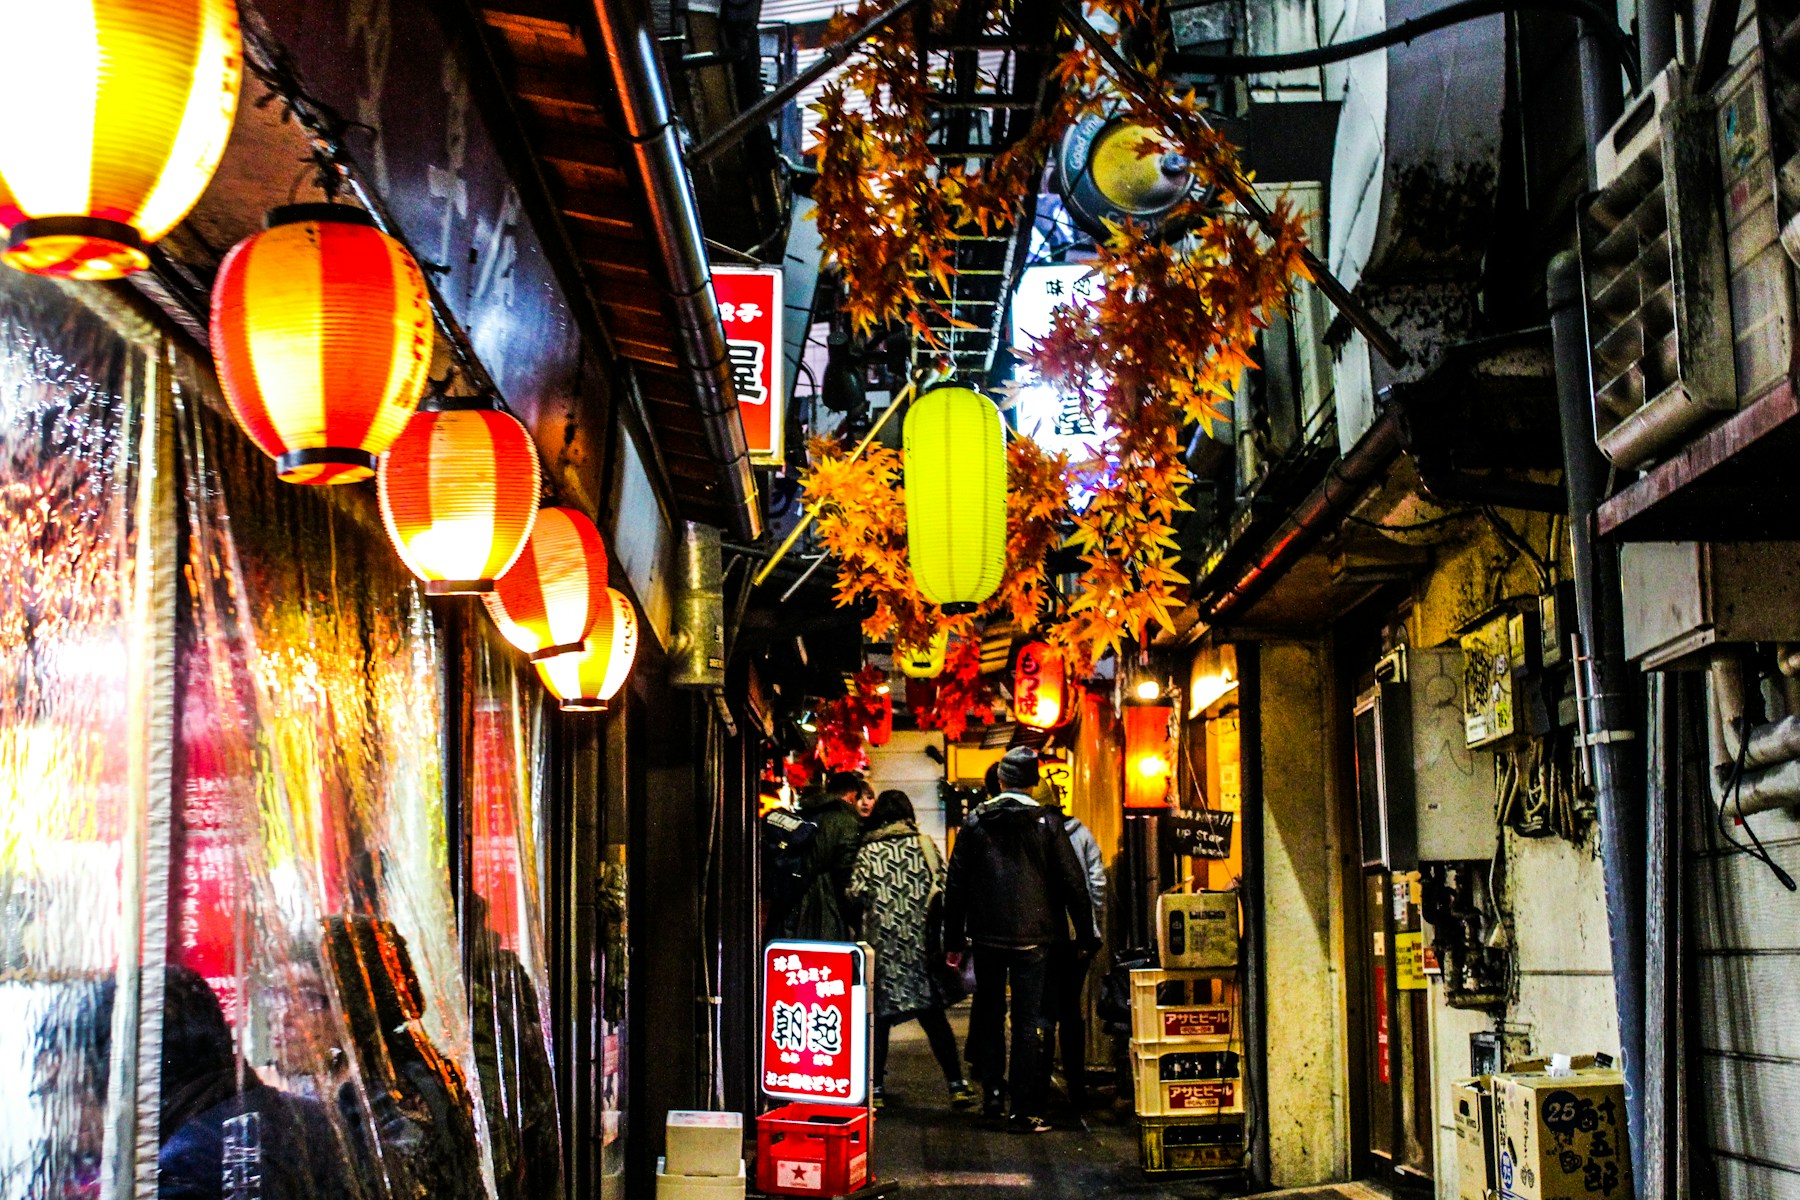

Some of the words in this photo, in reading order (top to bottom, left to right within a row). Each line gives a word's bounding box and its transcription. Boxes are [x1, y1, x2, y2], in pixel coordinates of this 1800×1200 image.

[1018, 651, 1040, 716] もつ焼
[1165, 1011, 1228, 1025] アサヒビール
[1169, 1085, 1233, 1098] アサヒビール
[1548, 1102, 1576, 1122] 25
